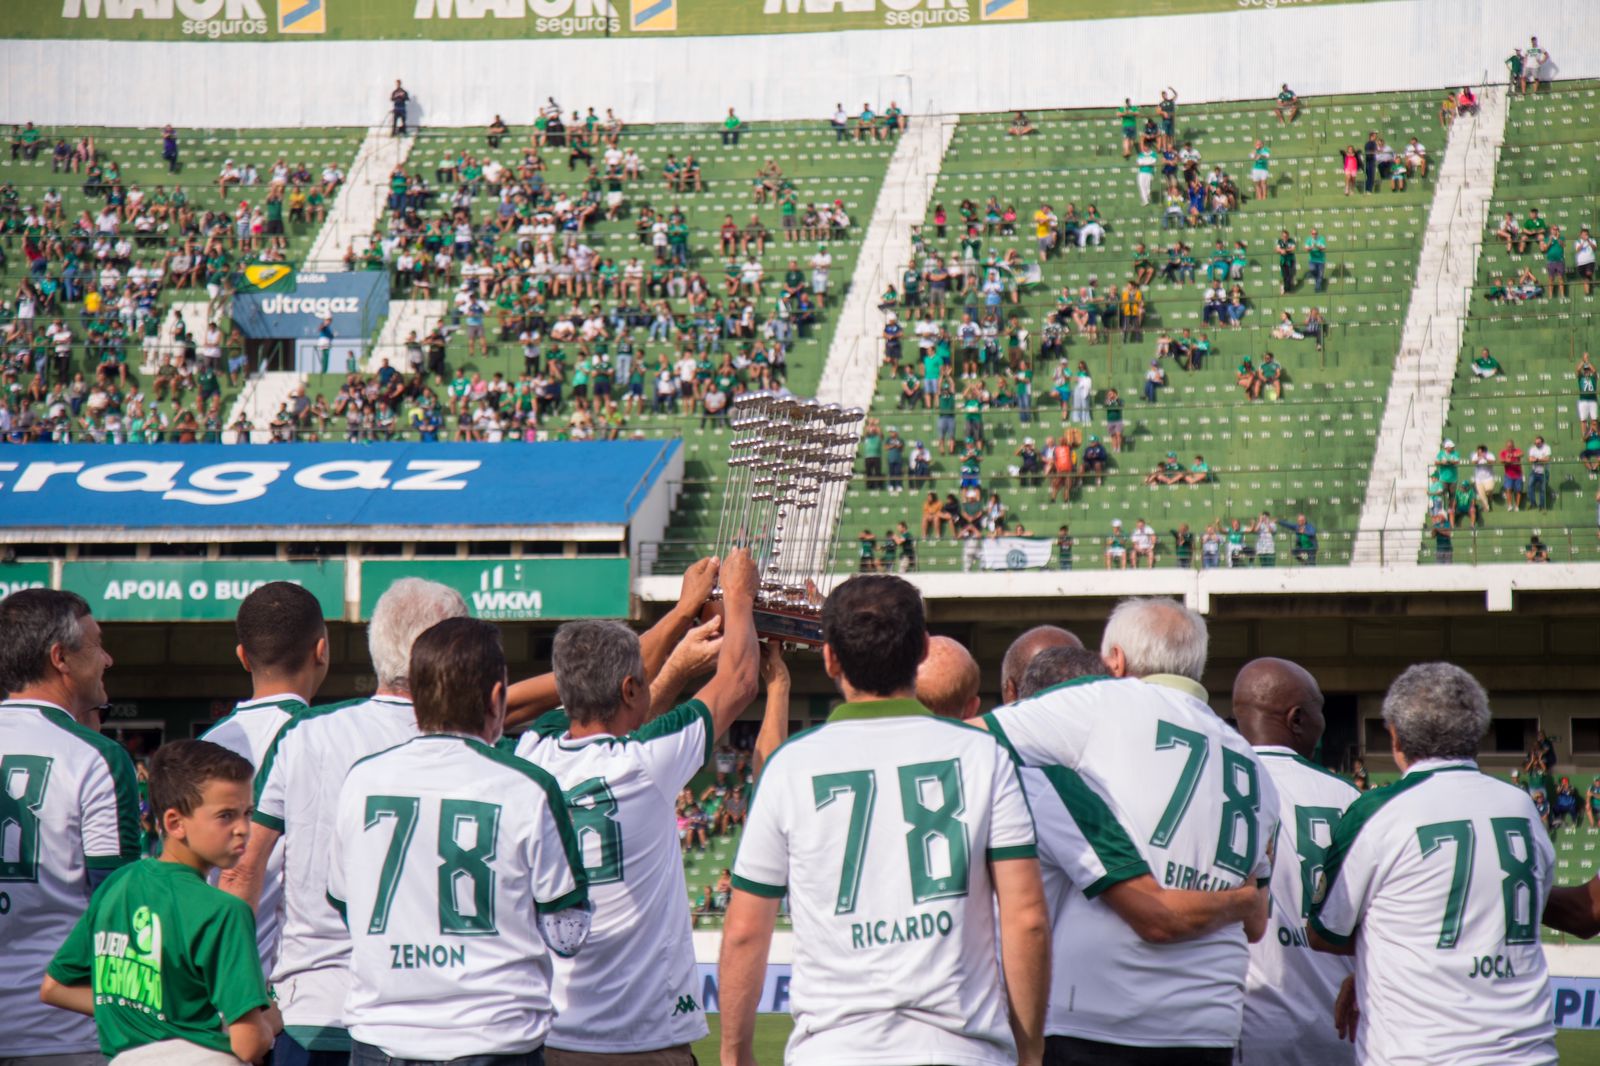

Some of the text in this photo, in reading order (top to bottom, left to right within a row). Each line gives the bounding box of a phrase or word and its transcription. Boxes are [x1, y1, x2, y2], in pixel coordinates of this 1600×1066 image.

[181, 18, 268, 38] seguros
[535, 17, 621, 36] seguros
[884, 8, 970, 28] seguros
[262, 294, 360, 318] ultragaz
[103, 580, 182, 600] APOIA
[188, 580, 209, 600] O
[471, 590, 542, 610] WKM
[1150, 719, 1261, 879] 78
[812, 757, 970, 915] 78
[364, 795, 502, 936] 78
[1416, 816, 1539, 949] 78
[851, 910, 953, 949] RICARDO
[390, 944, 465, 969] ZENON
[1469, 955, 1515, 978] JOCA
